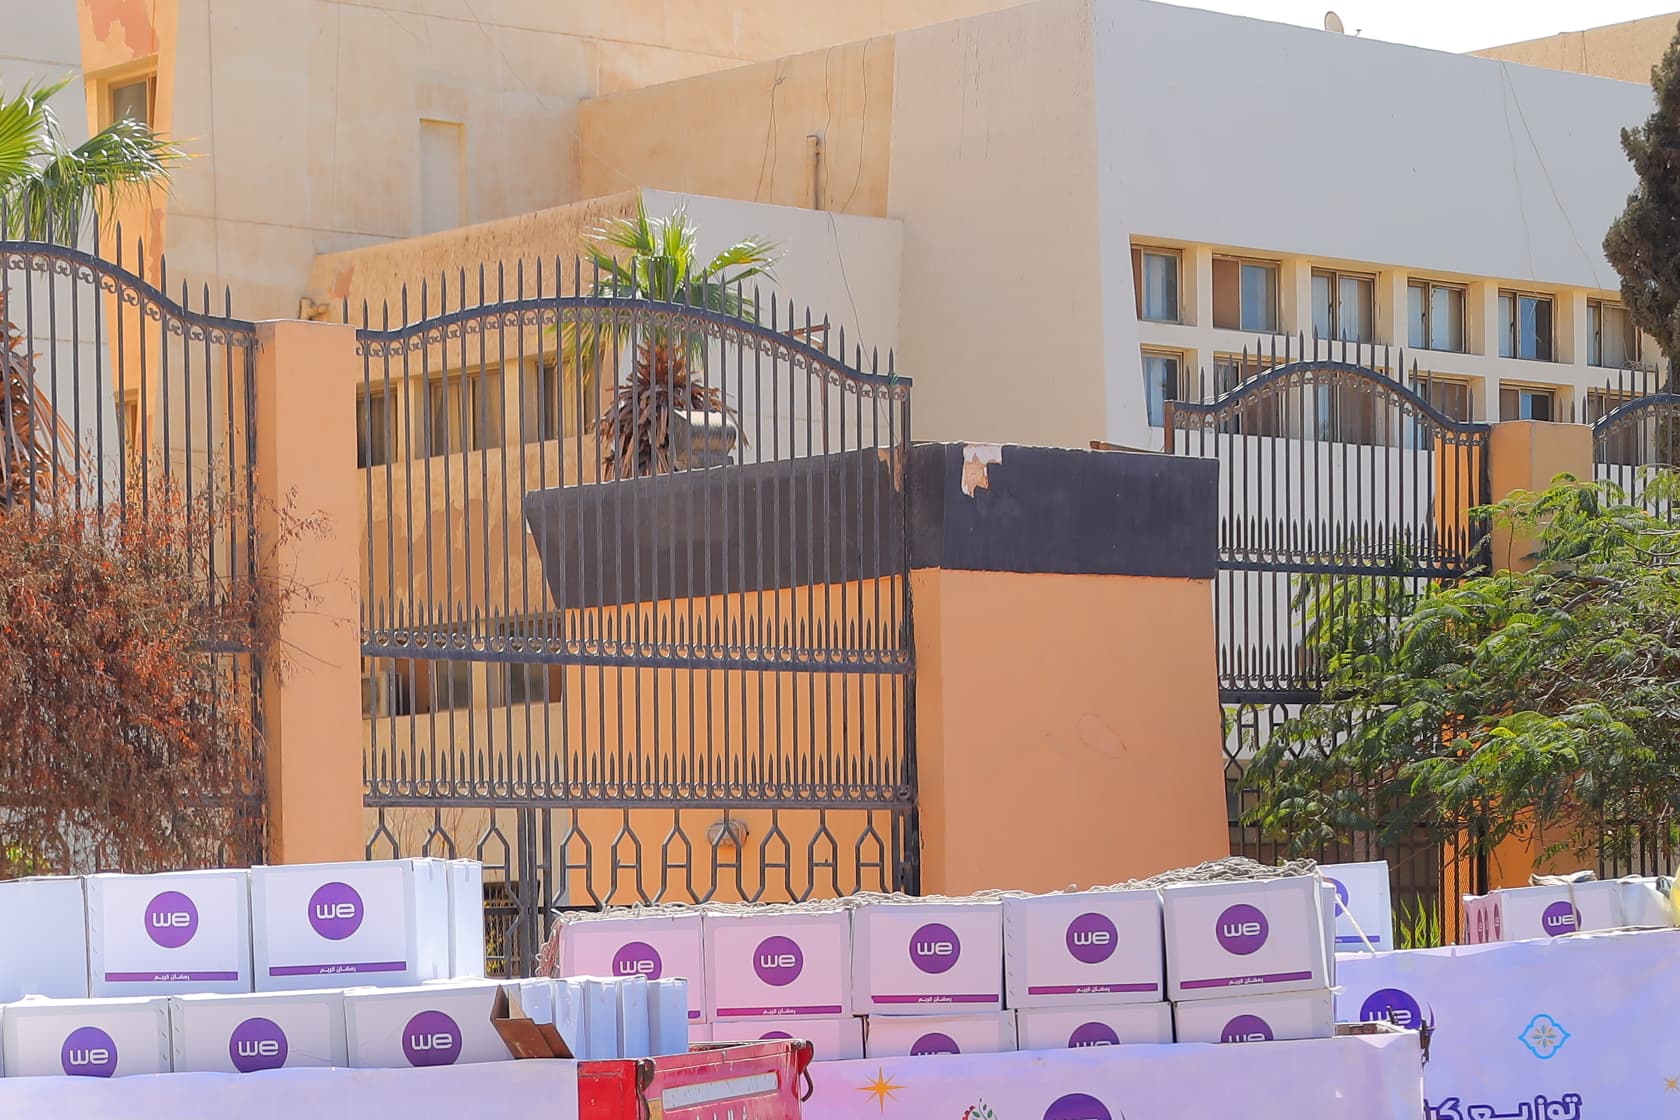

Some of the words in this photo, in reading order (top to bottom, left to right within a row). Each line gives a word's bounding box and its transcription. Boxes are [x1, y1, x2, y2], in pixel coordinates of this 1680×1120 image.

[316, 902, 356, 919] we
[152, 911, 191, 928] we
[1224, 921, 1261, 937] we
[1073, 931, 1110, 945] we
[917, 942, 953, 955] we
[619, 960, 655, 974] we
[760, 954, 796, 968] we
[238, 1040, 279, 1056] we
[411, 1033, 453, 1050] we
[69, 1048, 109, 1065] we
